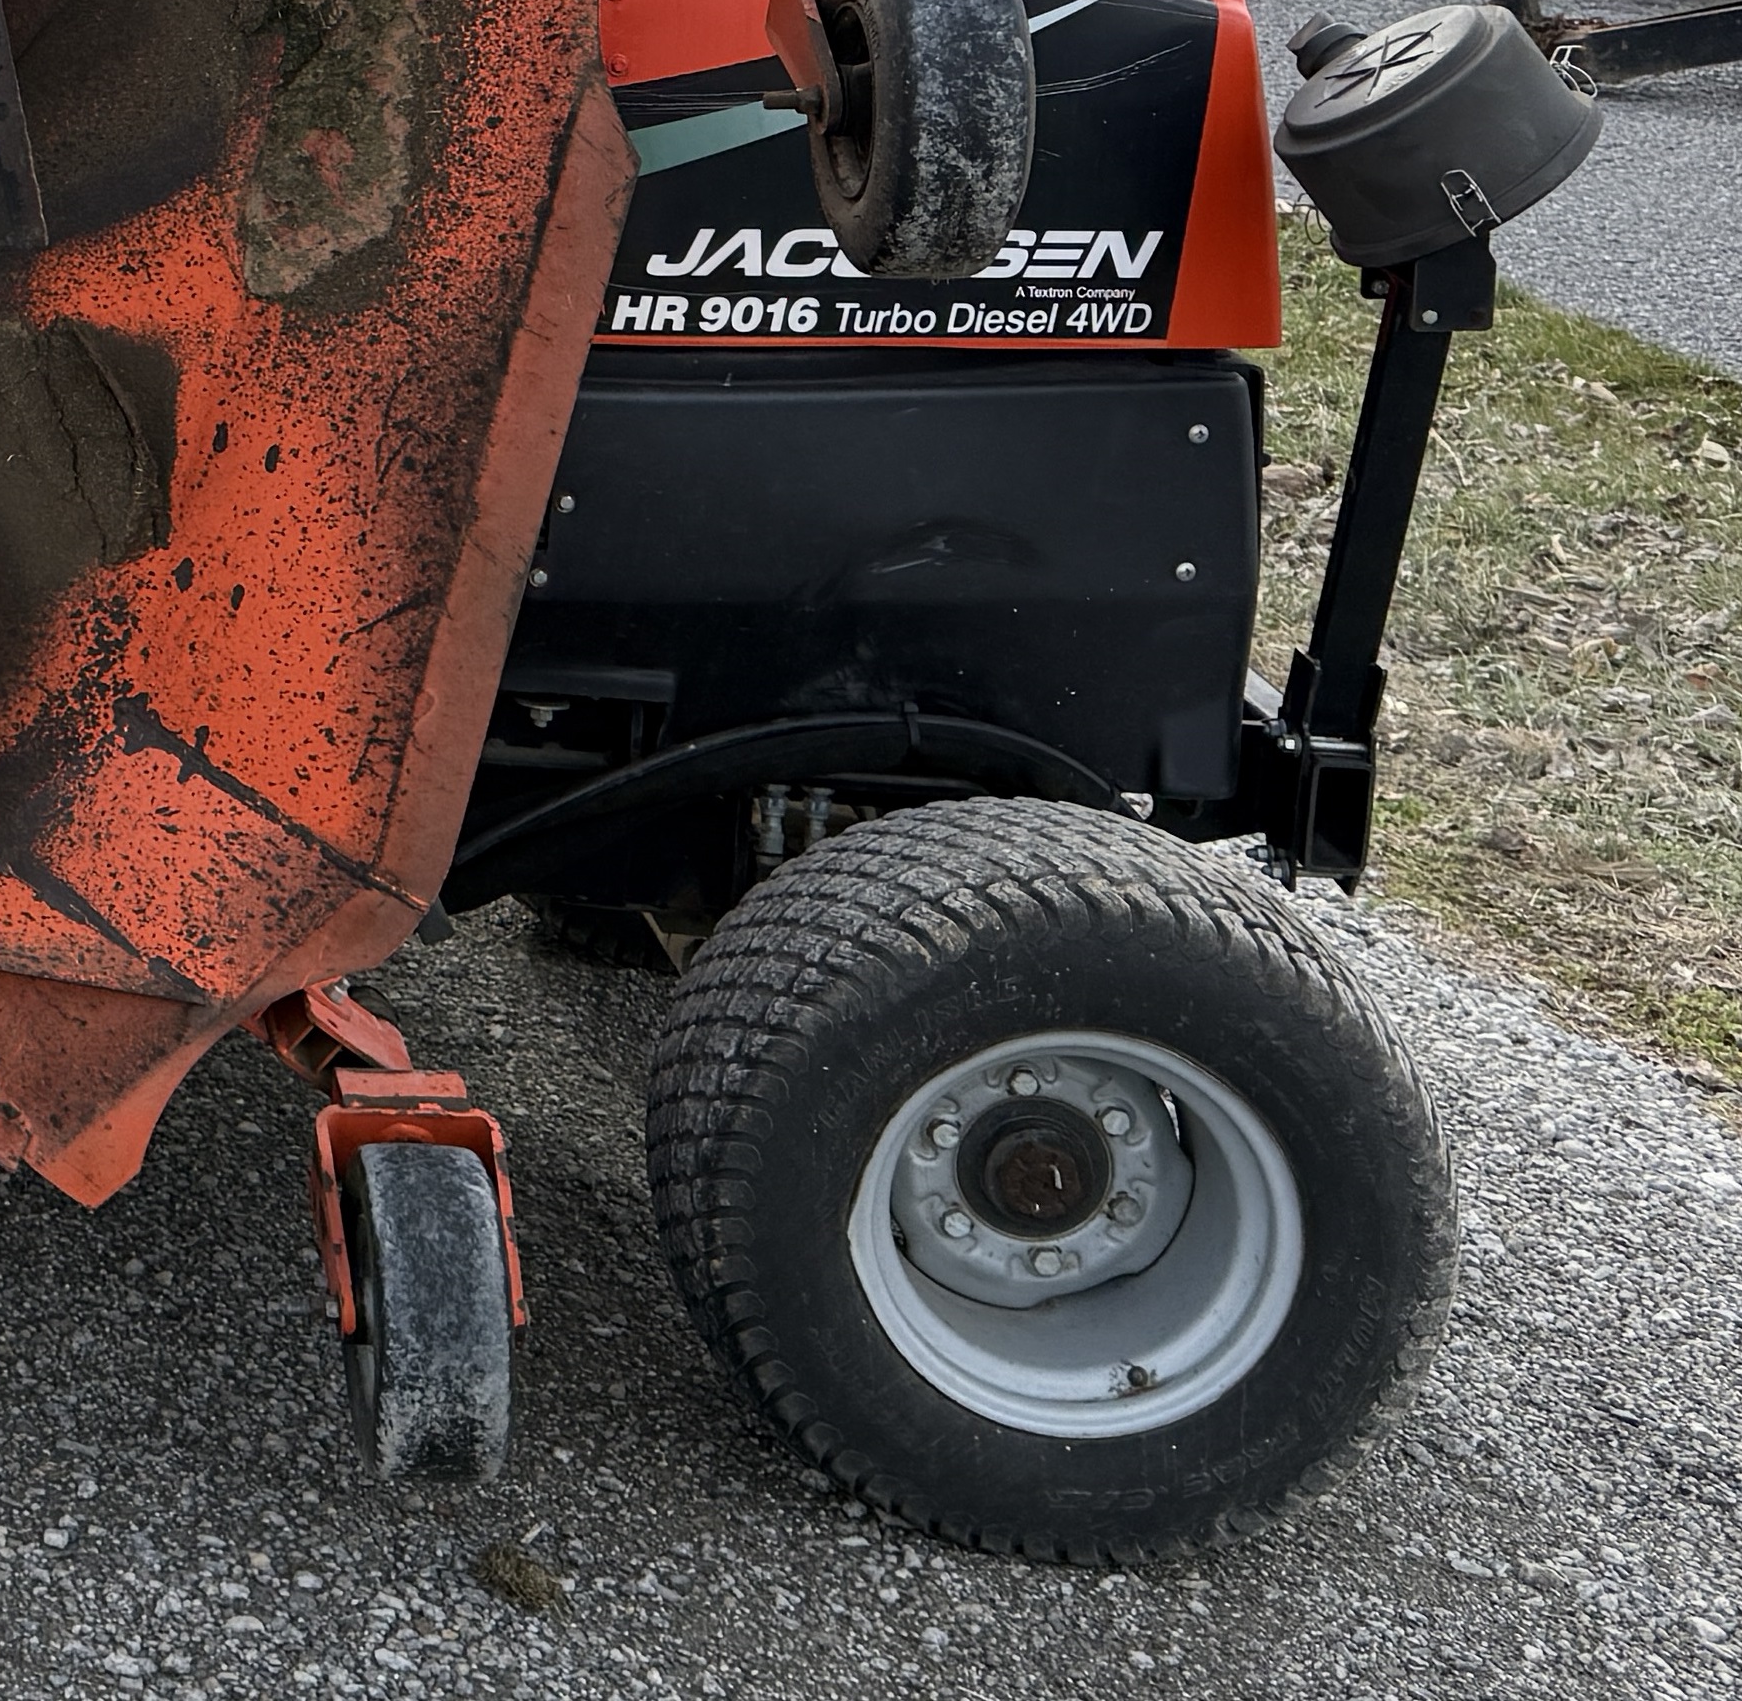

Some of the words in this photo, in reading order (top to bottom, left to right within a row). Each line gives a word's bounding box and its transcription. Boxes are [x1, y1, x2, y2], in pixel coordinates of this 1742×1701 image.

[646, 228, 1164, 279] JACSEN
[1016, 286, 1025, 298] A
[1076, 286, 1136, 301] Company
[611, 295, 689, 331] HR
[698, 296, 821, 333] 9016
[835, 302, 937, 334] Turbo
[947, 302, 1059, 334] Diesel
[1066, 302, 1153, 334] 4WD
